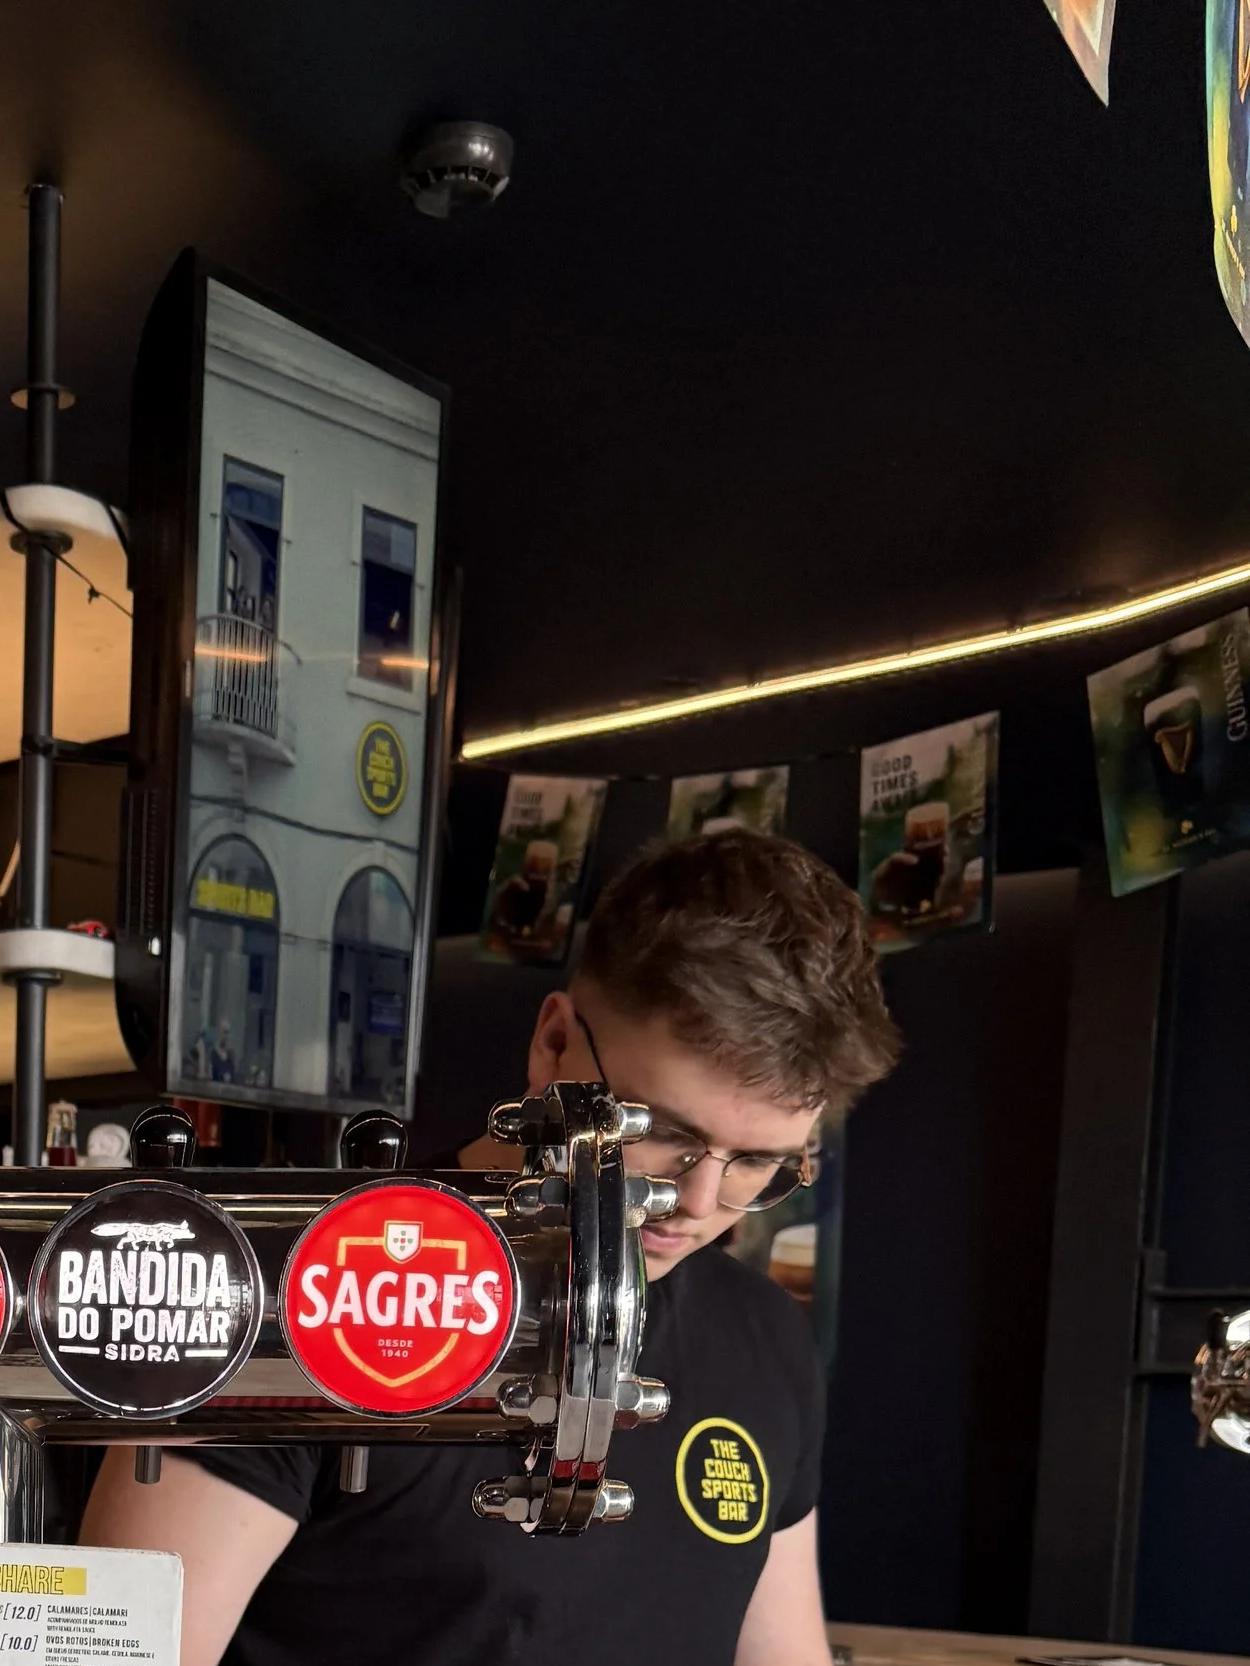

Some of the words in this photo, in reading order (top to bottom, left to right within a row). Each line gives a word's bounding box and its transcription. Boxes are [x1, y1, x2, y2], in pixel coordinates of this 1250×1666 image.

[1221, 633, 1248, 742] GUINNESS
[872, 770, 919, 797] TIMES
[58, 1250, 231, 1308] BANDIDA
[298, 1264, 500, 1335] SAGRES
[58, 1306, 99, 1340] DO
[111, 1308, 230, 1343] POMAR
[105, 1343, 180, 1361] SIDRA
[378, 1339, 413, 1348] DESDE
[382, 1349, 409, 1358] 1940
[710, 1439, 740, 1460] THE
[704, 1458, 751, 1482] COUCH
[701, 1479, 758, 1503] SPORTS
[718, 1500, 749, 1522] BAR
